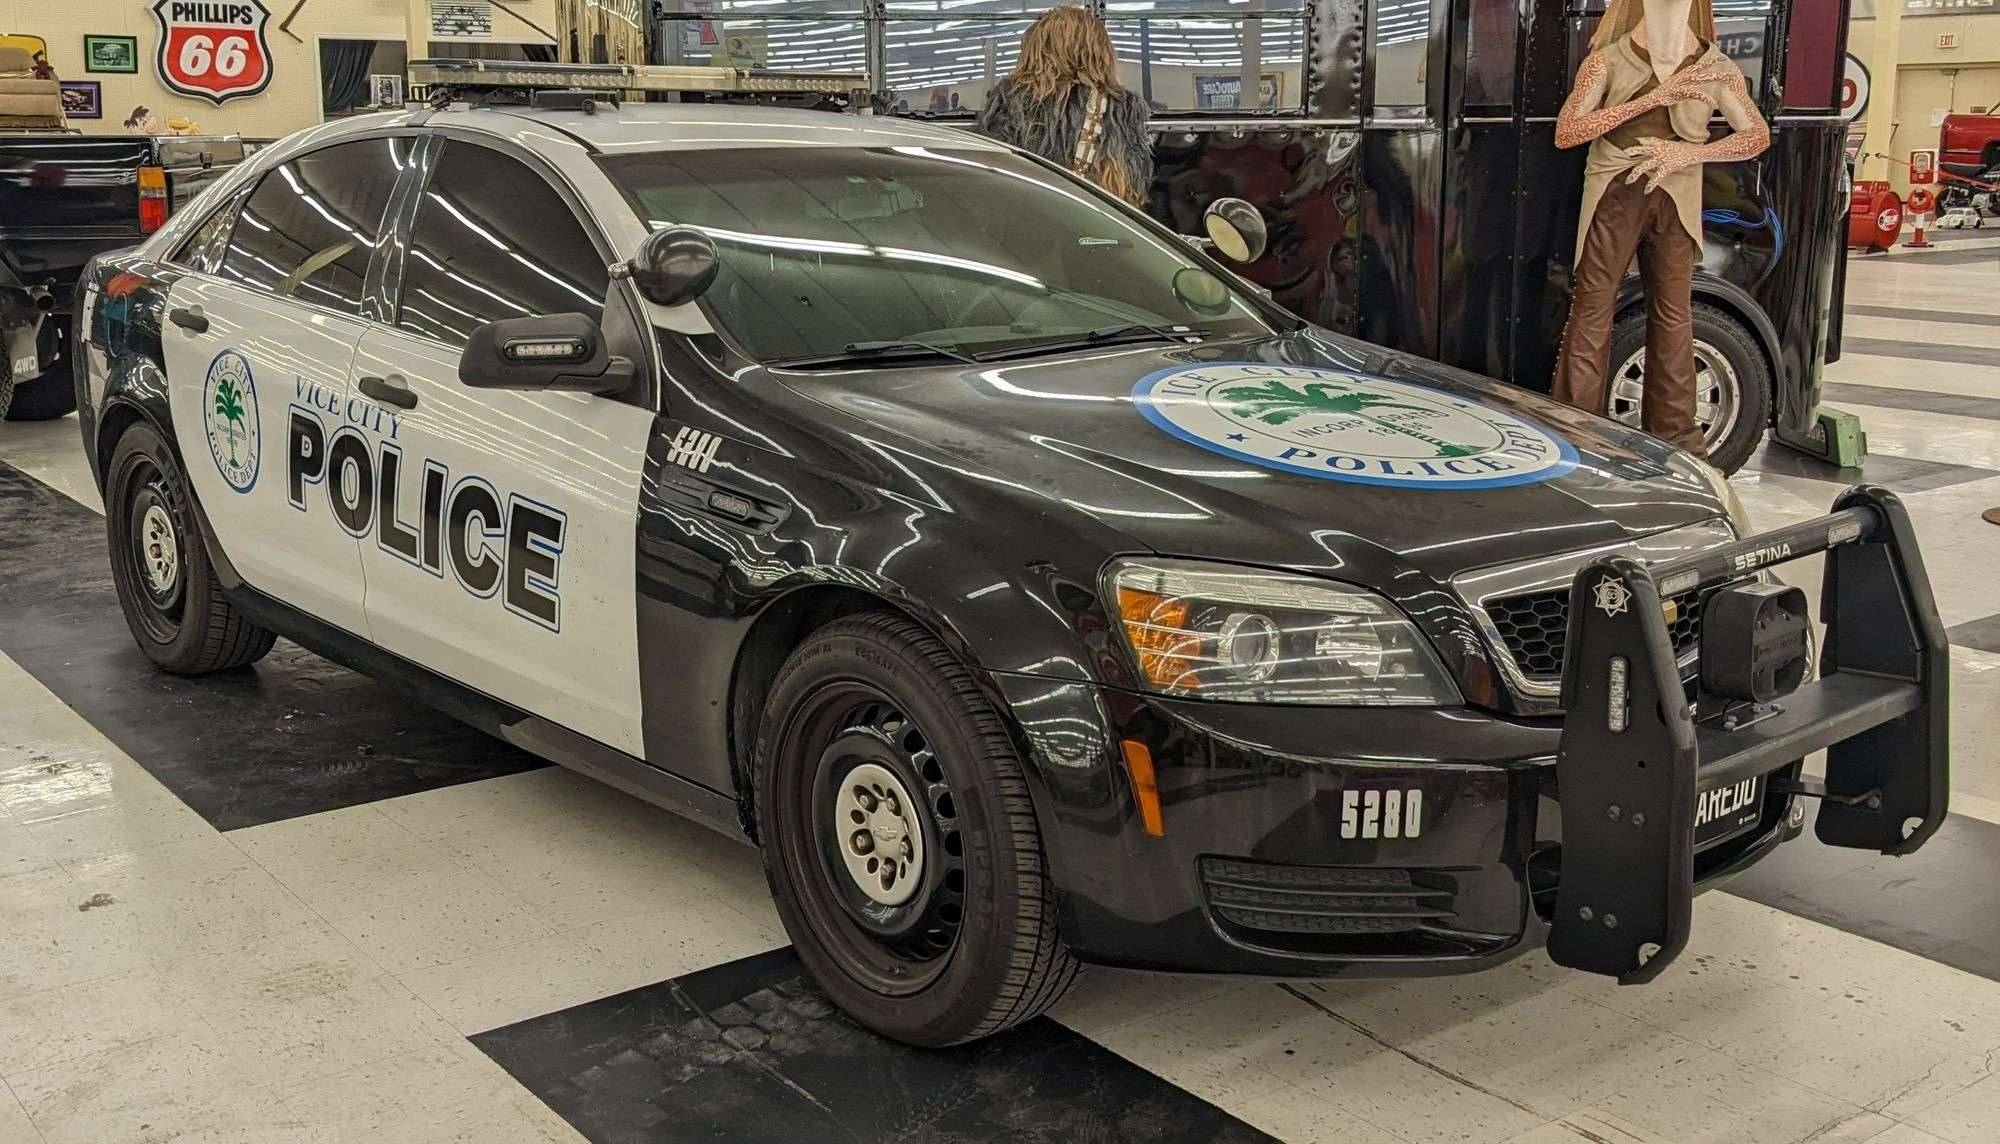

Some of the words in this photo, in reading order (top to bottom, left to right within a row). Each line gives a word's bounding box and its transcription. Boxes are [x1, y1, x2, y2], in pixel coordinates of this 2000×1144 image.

[171, 2, 254, 25] PHILLIPS
[179, 34, 250, 77] 66
[1940, 34, 1955, 47] EXIT
[13, 355, 37, 374] 4WD
[210, 356, 230, 384] VICE
[234, 359, 252, 395] CITY
[1240, 366, 1371, 384] CITY
[295, 375, 342, 416] VICE
[347, 398, 403, 440] CITY
[209, 431, 238, 484] POLICE
[1276, 446, 1516, 477] POLICE
[287, 402, 568, 635] POLICE
[1734, 543, 1792, 571] SETINA
[1340, 789, 1423, 839] 5280
